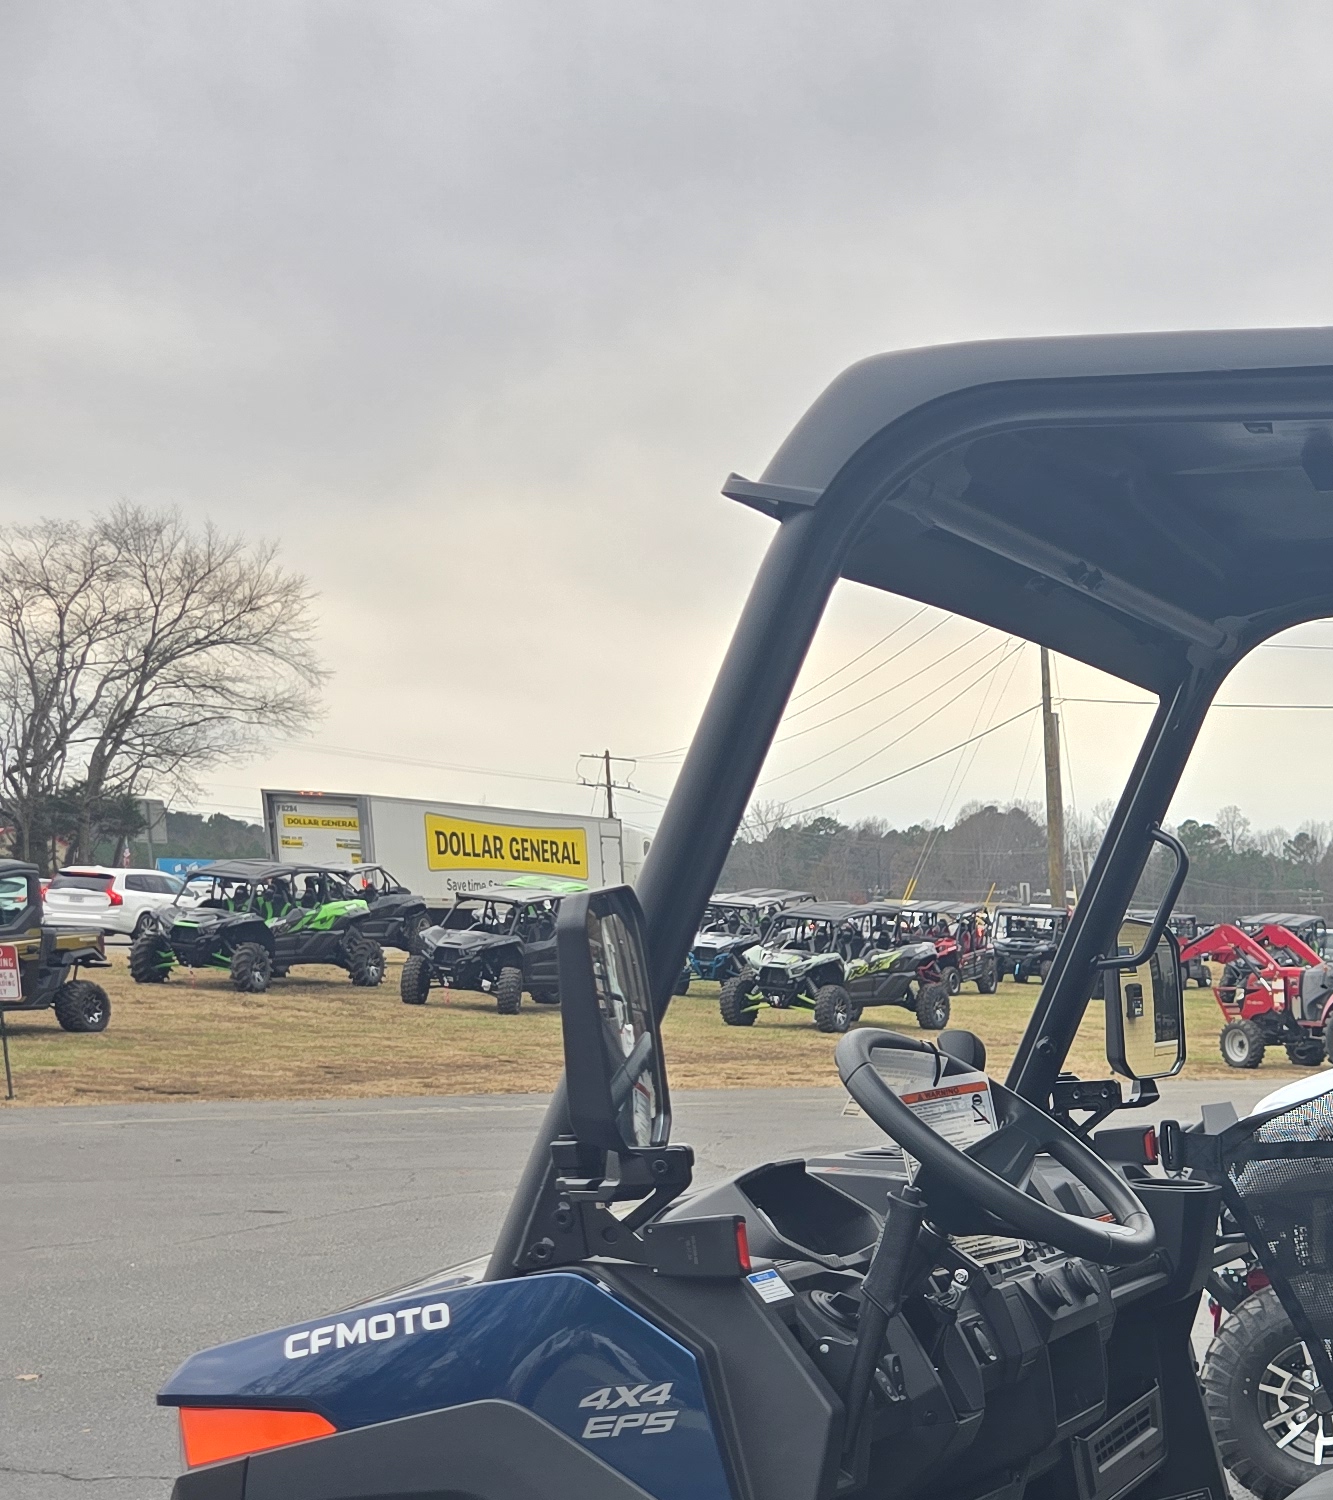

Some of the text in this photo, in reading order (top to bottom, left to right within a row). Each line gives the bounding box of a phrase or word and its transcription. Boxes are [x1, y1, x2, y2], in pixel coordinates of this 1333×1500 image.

[287, 817, 358, 828] DOLLAR GENERAL
[435, 829, 580, 865] DOLLAR GENERAL
[446, 877, 467, 891] Save
[924, 1086, 960, 1100] WARNING
[283, 1302, 451, 1360] CFMOTO
[578, 1381, 674, 1411] 4X4
[580, 1410, 677, 1440] EPS
